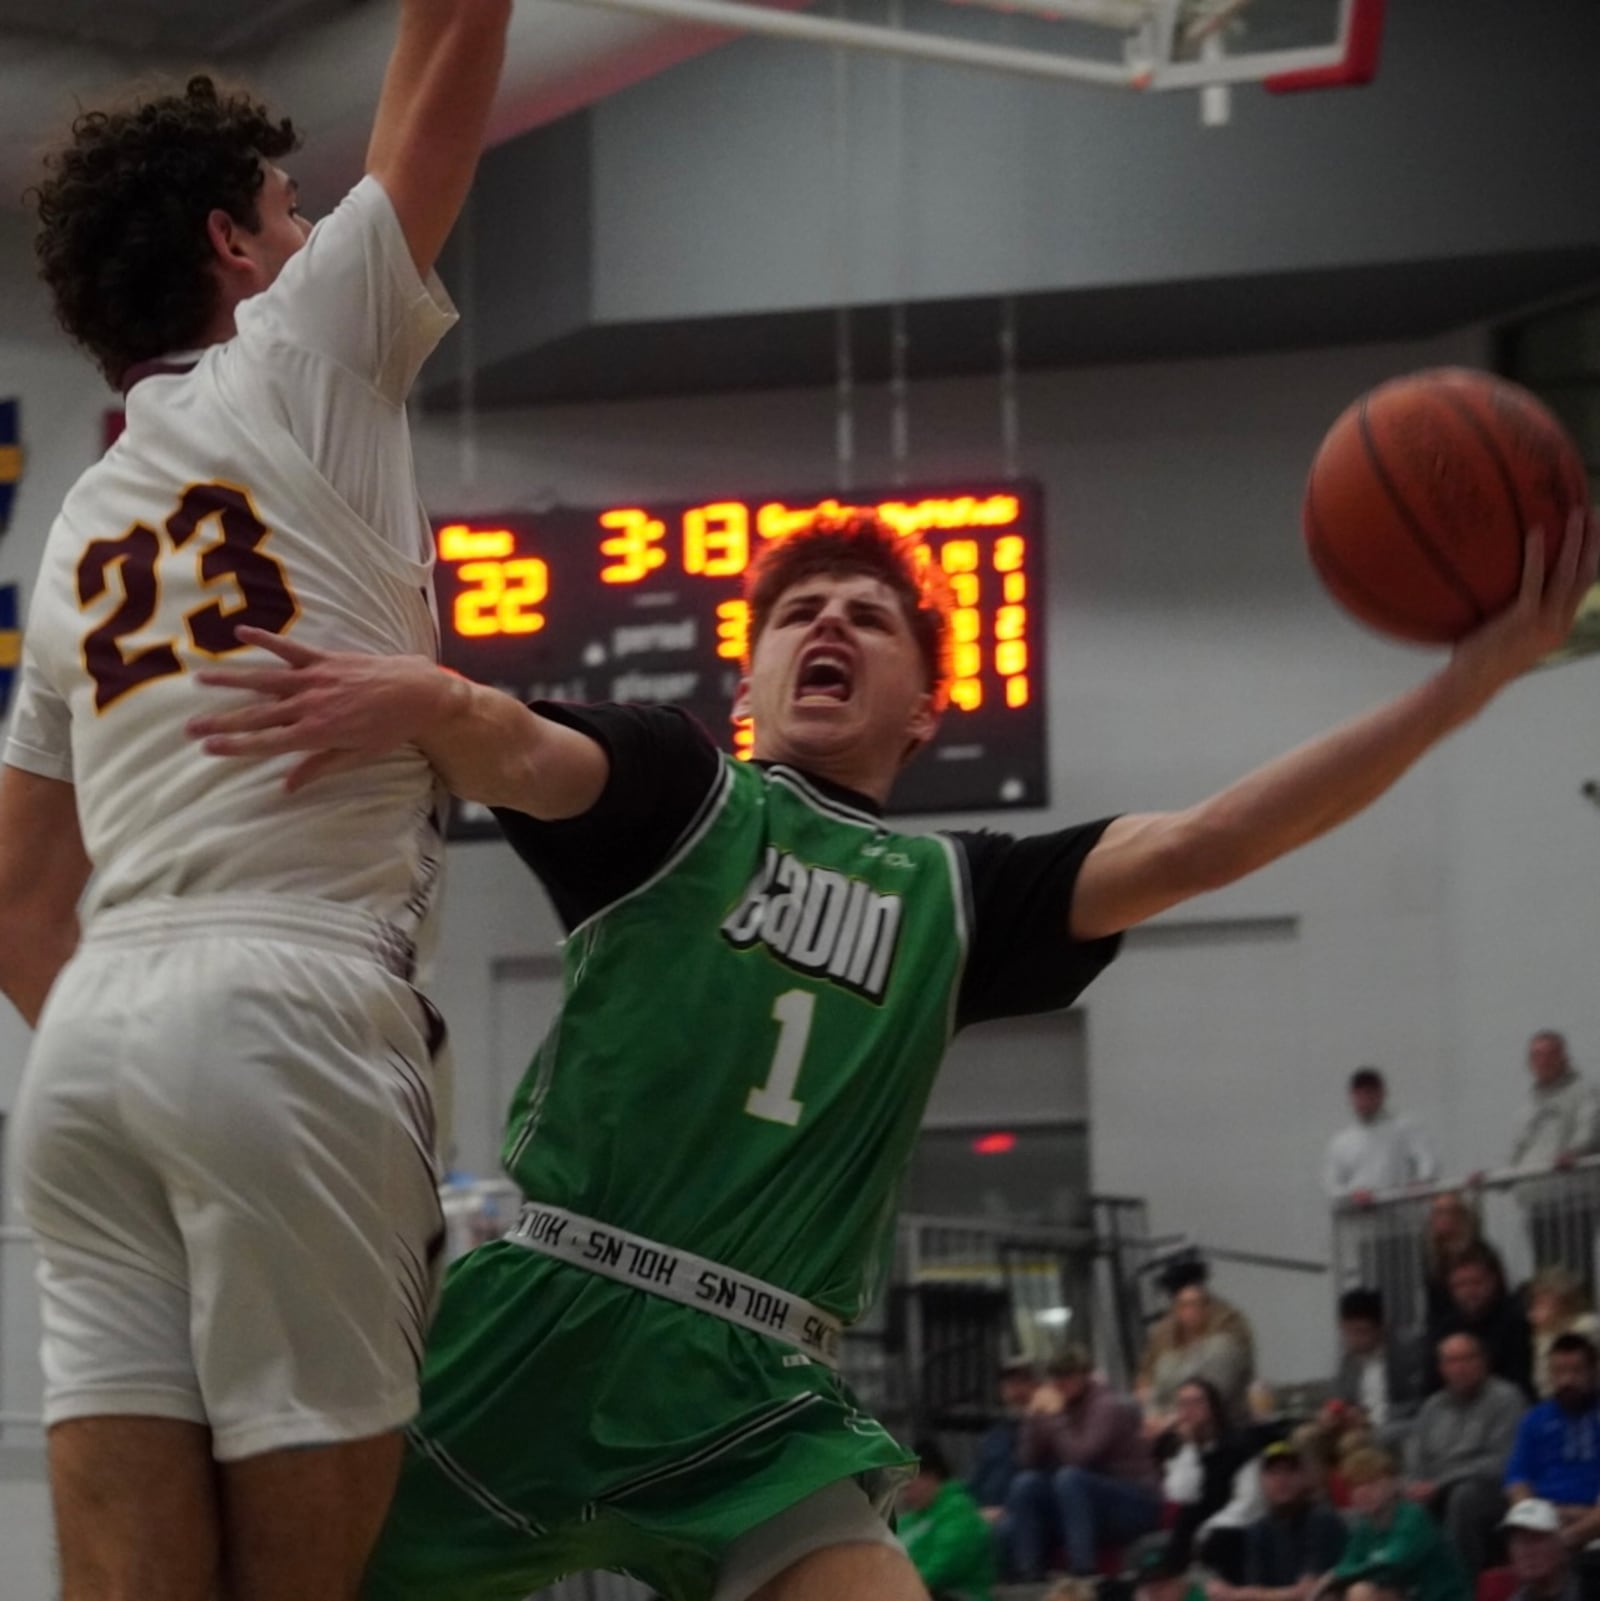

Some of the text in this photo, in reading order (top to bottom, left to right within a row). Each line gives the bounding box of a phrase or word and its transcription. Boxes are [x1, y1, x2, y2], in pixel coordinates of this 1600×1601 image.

[74, 478, 302, 718] 23
[454, 558, 548, 636] 22
[744, 988, 816, 1127] 1
